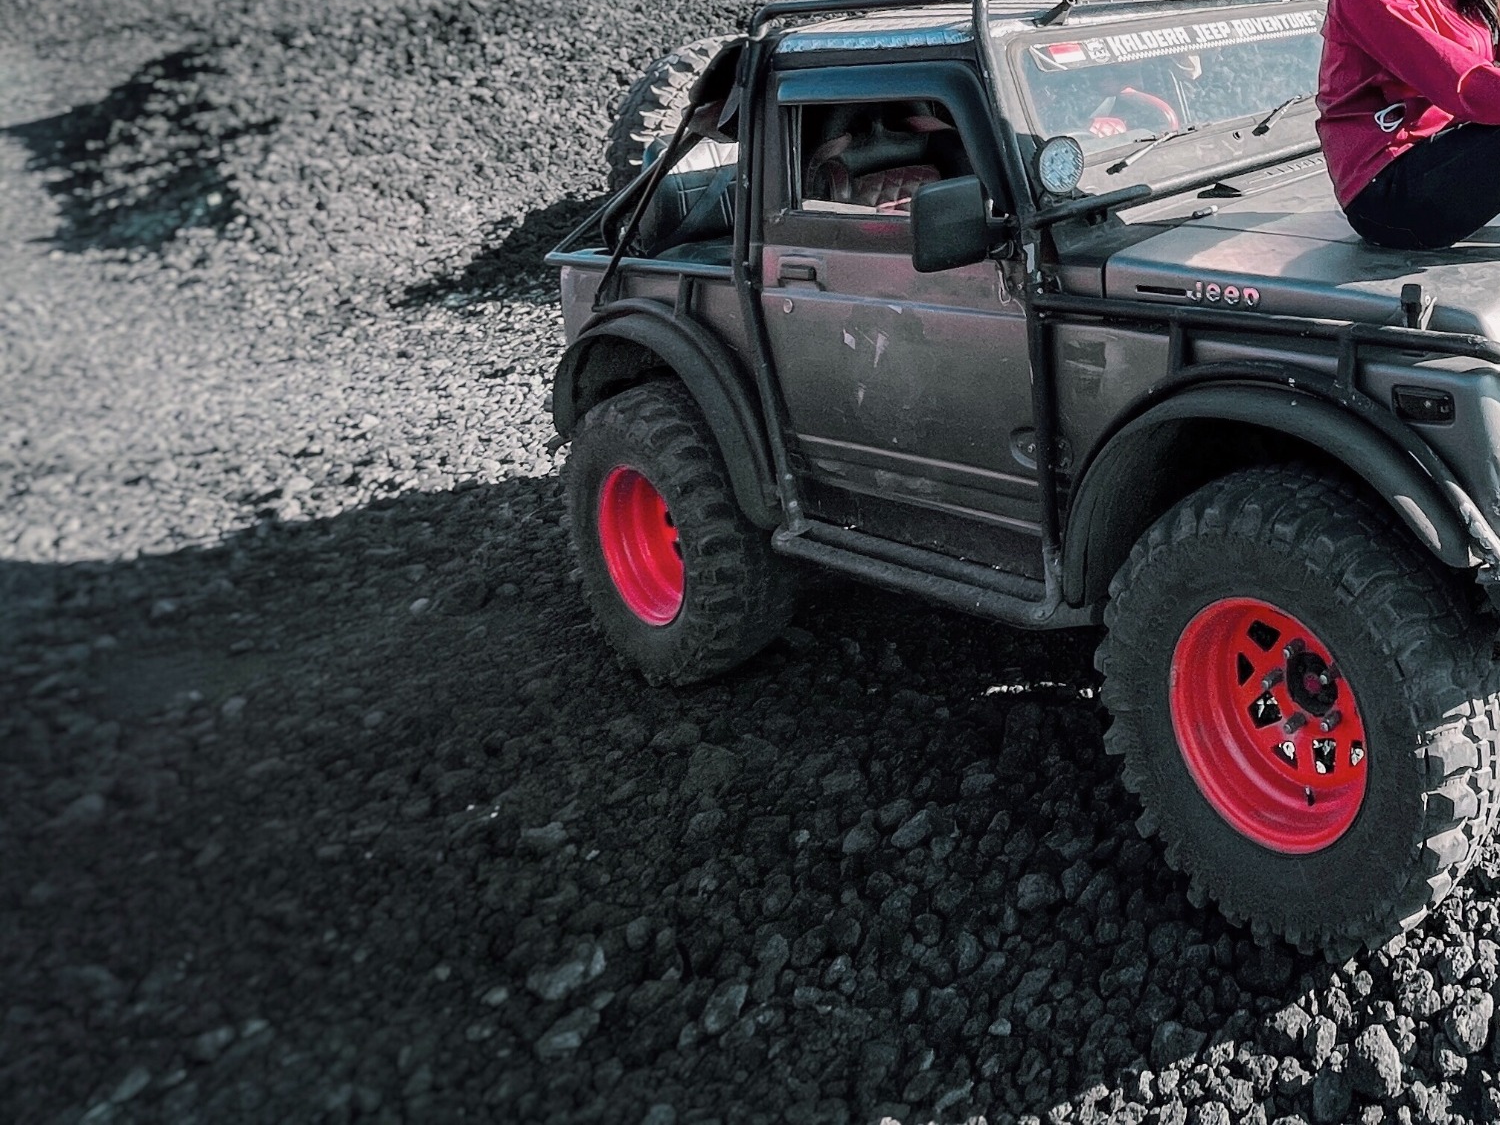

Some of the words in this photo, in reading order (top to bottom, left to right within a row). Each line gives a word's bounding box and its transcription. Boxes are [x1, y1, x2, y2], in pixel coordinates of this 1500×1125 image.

[1106, 25, 1191, 57] KALDERA
[1192, 21, 1231, 43] JEEP
[1231, 10, 1317, 38] ADVENTURE
